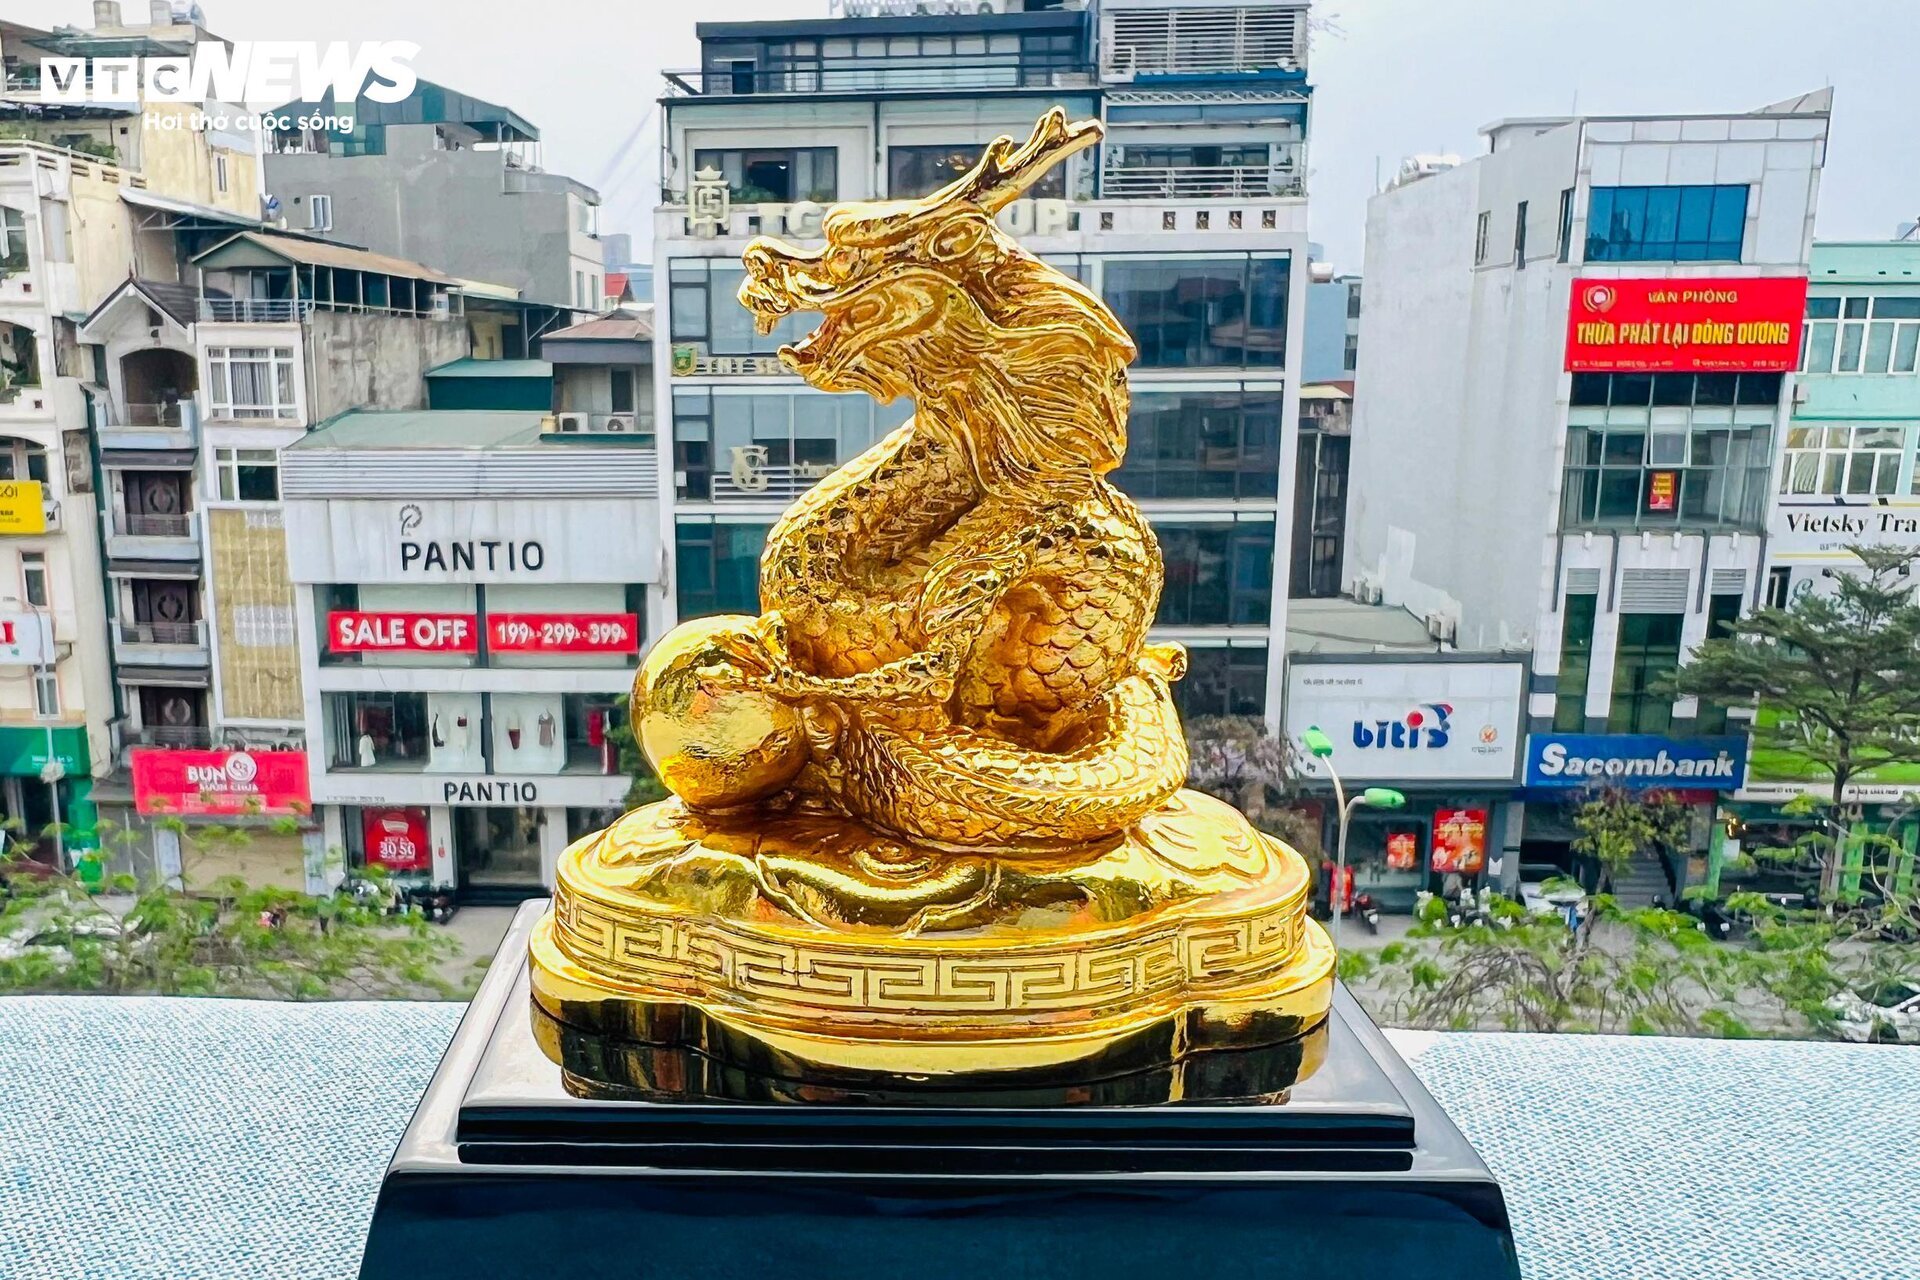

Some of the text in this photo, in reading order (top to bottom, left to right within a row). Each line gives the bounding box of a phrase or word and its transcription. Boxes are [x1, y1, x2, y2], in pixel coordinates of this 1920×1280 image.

[1787, 513, 1868, 538] Vietsky
[401, 541, 544, 571] PANTIO
[339, 618, 468, 647] SALE OFF
[1539, 743, 1735, 777] Sacombank
[444, 781, 537, 802] PANTIO
